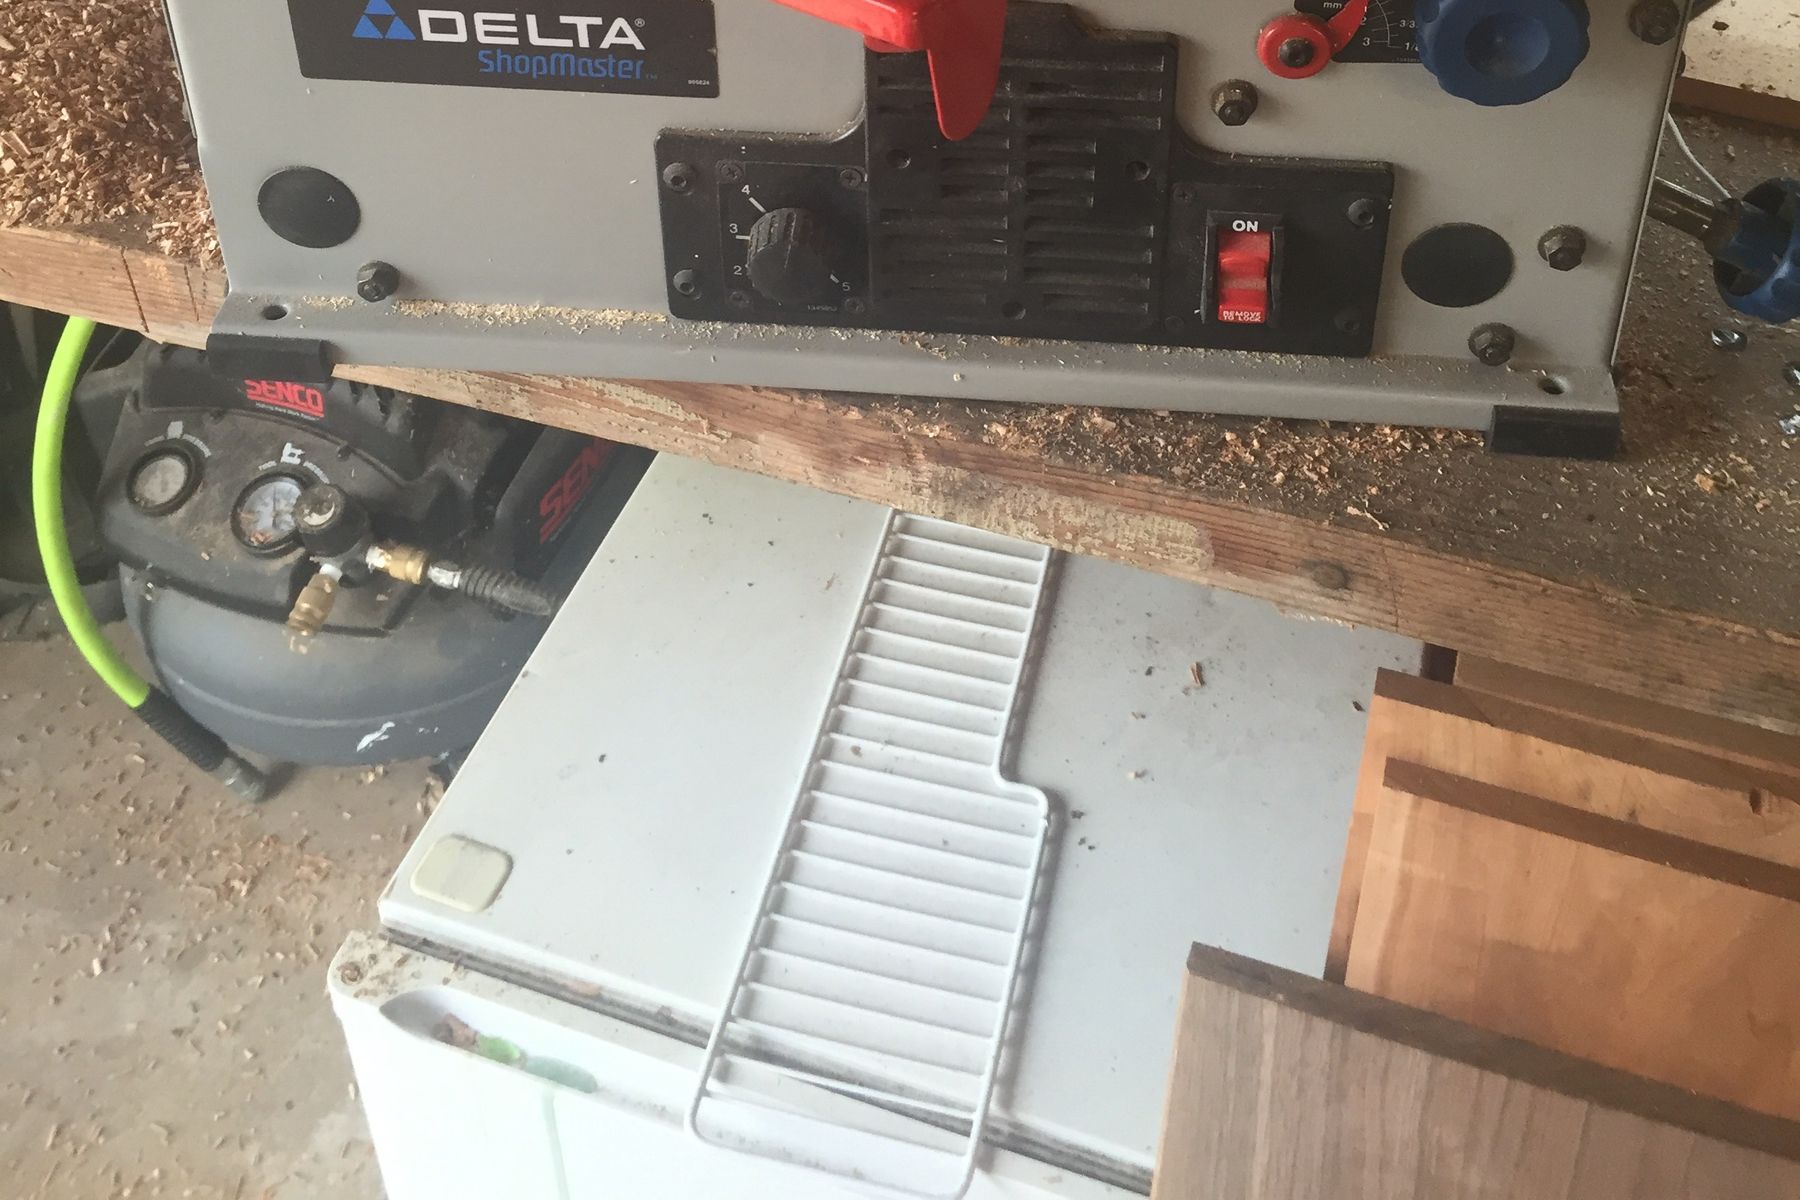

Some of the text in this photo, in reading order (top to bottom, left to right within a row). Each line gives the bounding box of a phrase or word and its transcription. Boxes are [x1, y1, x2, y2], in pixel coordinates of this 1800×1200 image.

[1400, 19, 1418, 29] 3/3
[1362, 37, 1370, 46] 3
[478, 49, 644, 80] ShopMaster
[741, 184, 750, 195] 4
[729, 223, 738, 234] 3
[1232, 220, 1259, 233] ON
[733, 265, 743, 276] 2
[842, 282, 850, 291] 5
[243, 379, 324, 413] SENCO
